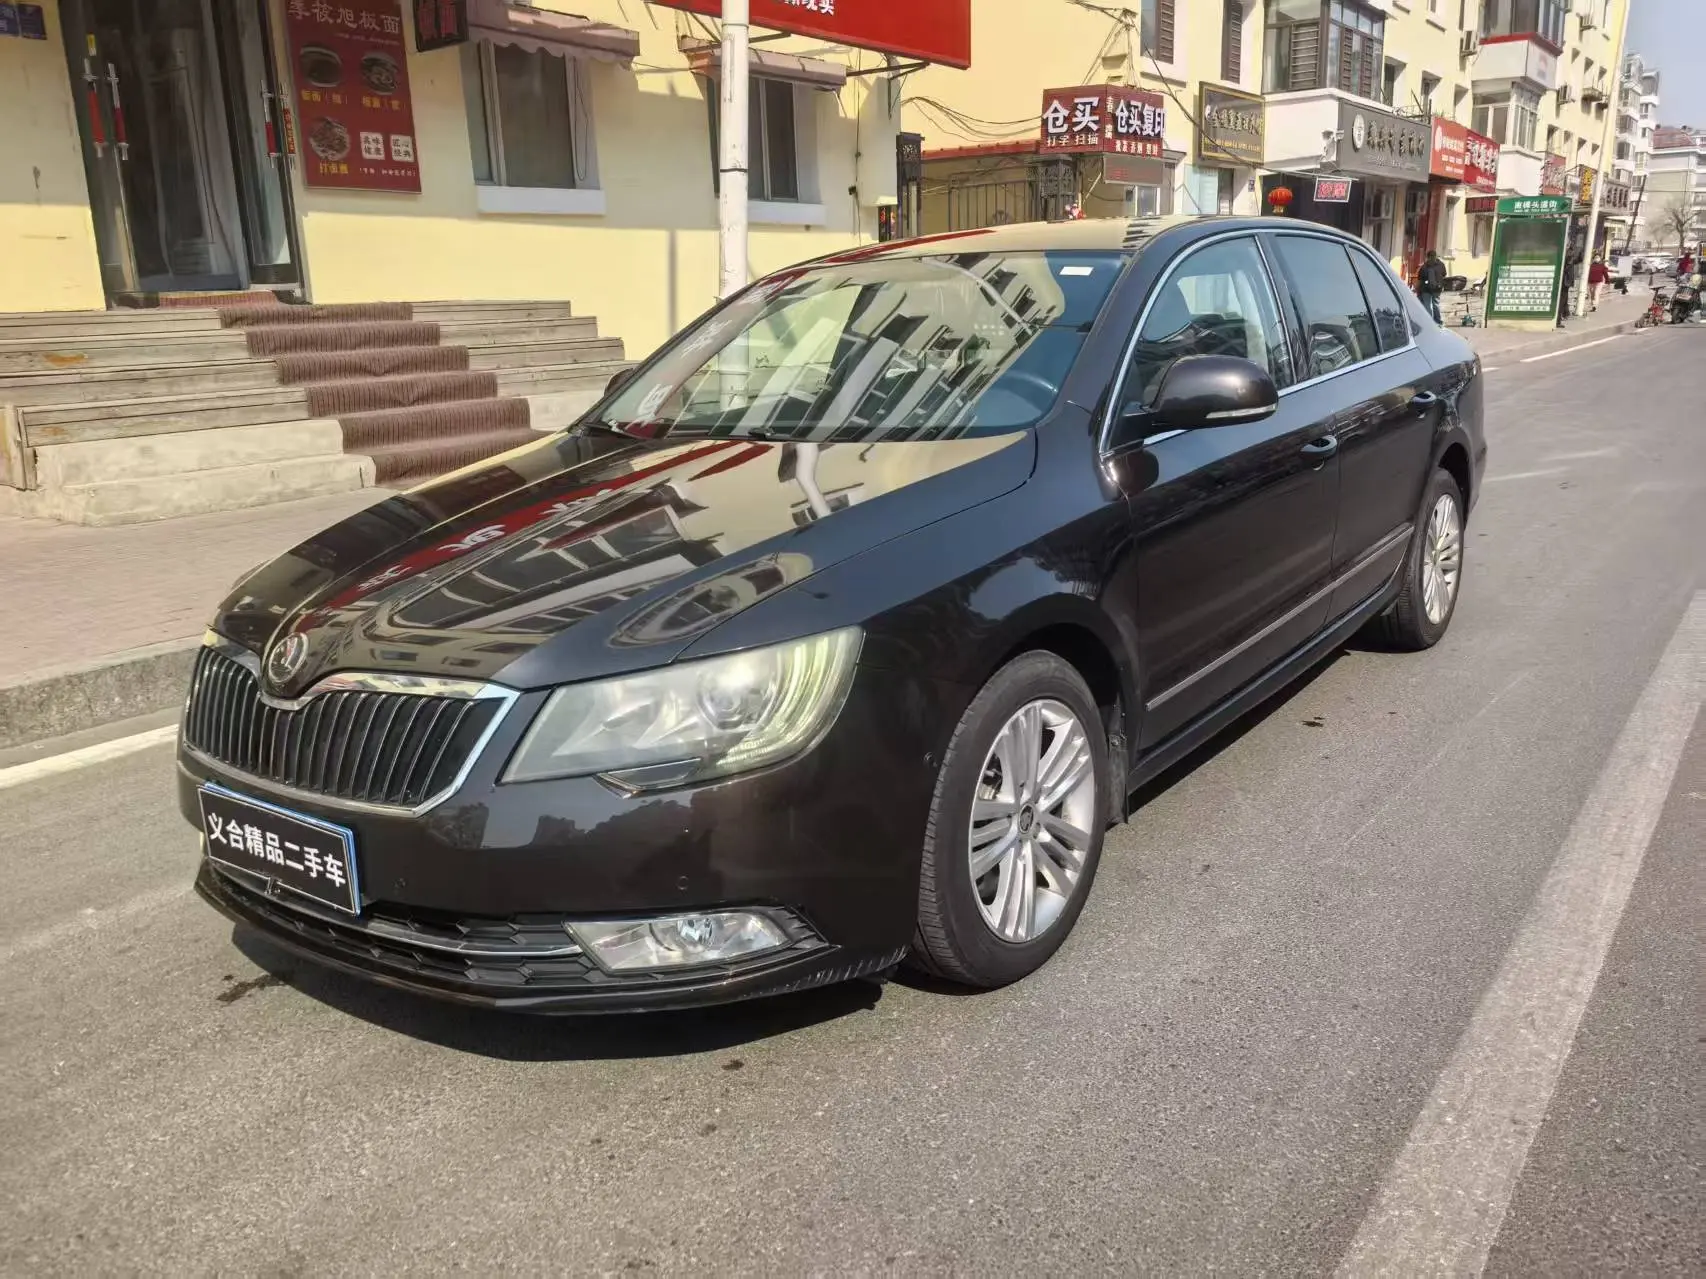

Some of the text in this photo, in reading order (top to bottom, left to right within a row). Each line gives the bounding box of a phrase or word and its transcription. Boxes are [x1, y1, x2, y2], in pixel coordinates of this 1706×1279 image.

[1043, 96, 1100, 134] 仓买
[1116, 99, 1166, 138] 仓买复印
[1047, 133, 1099, 147] 打字 扫描
[208, 812, 346, 888] 义合精品二手车
